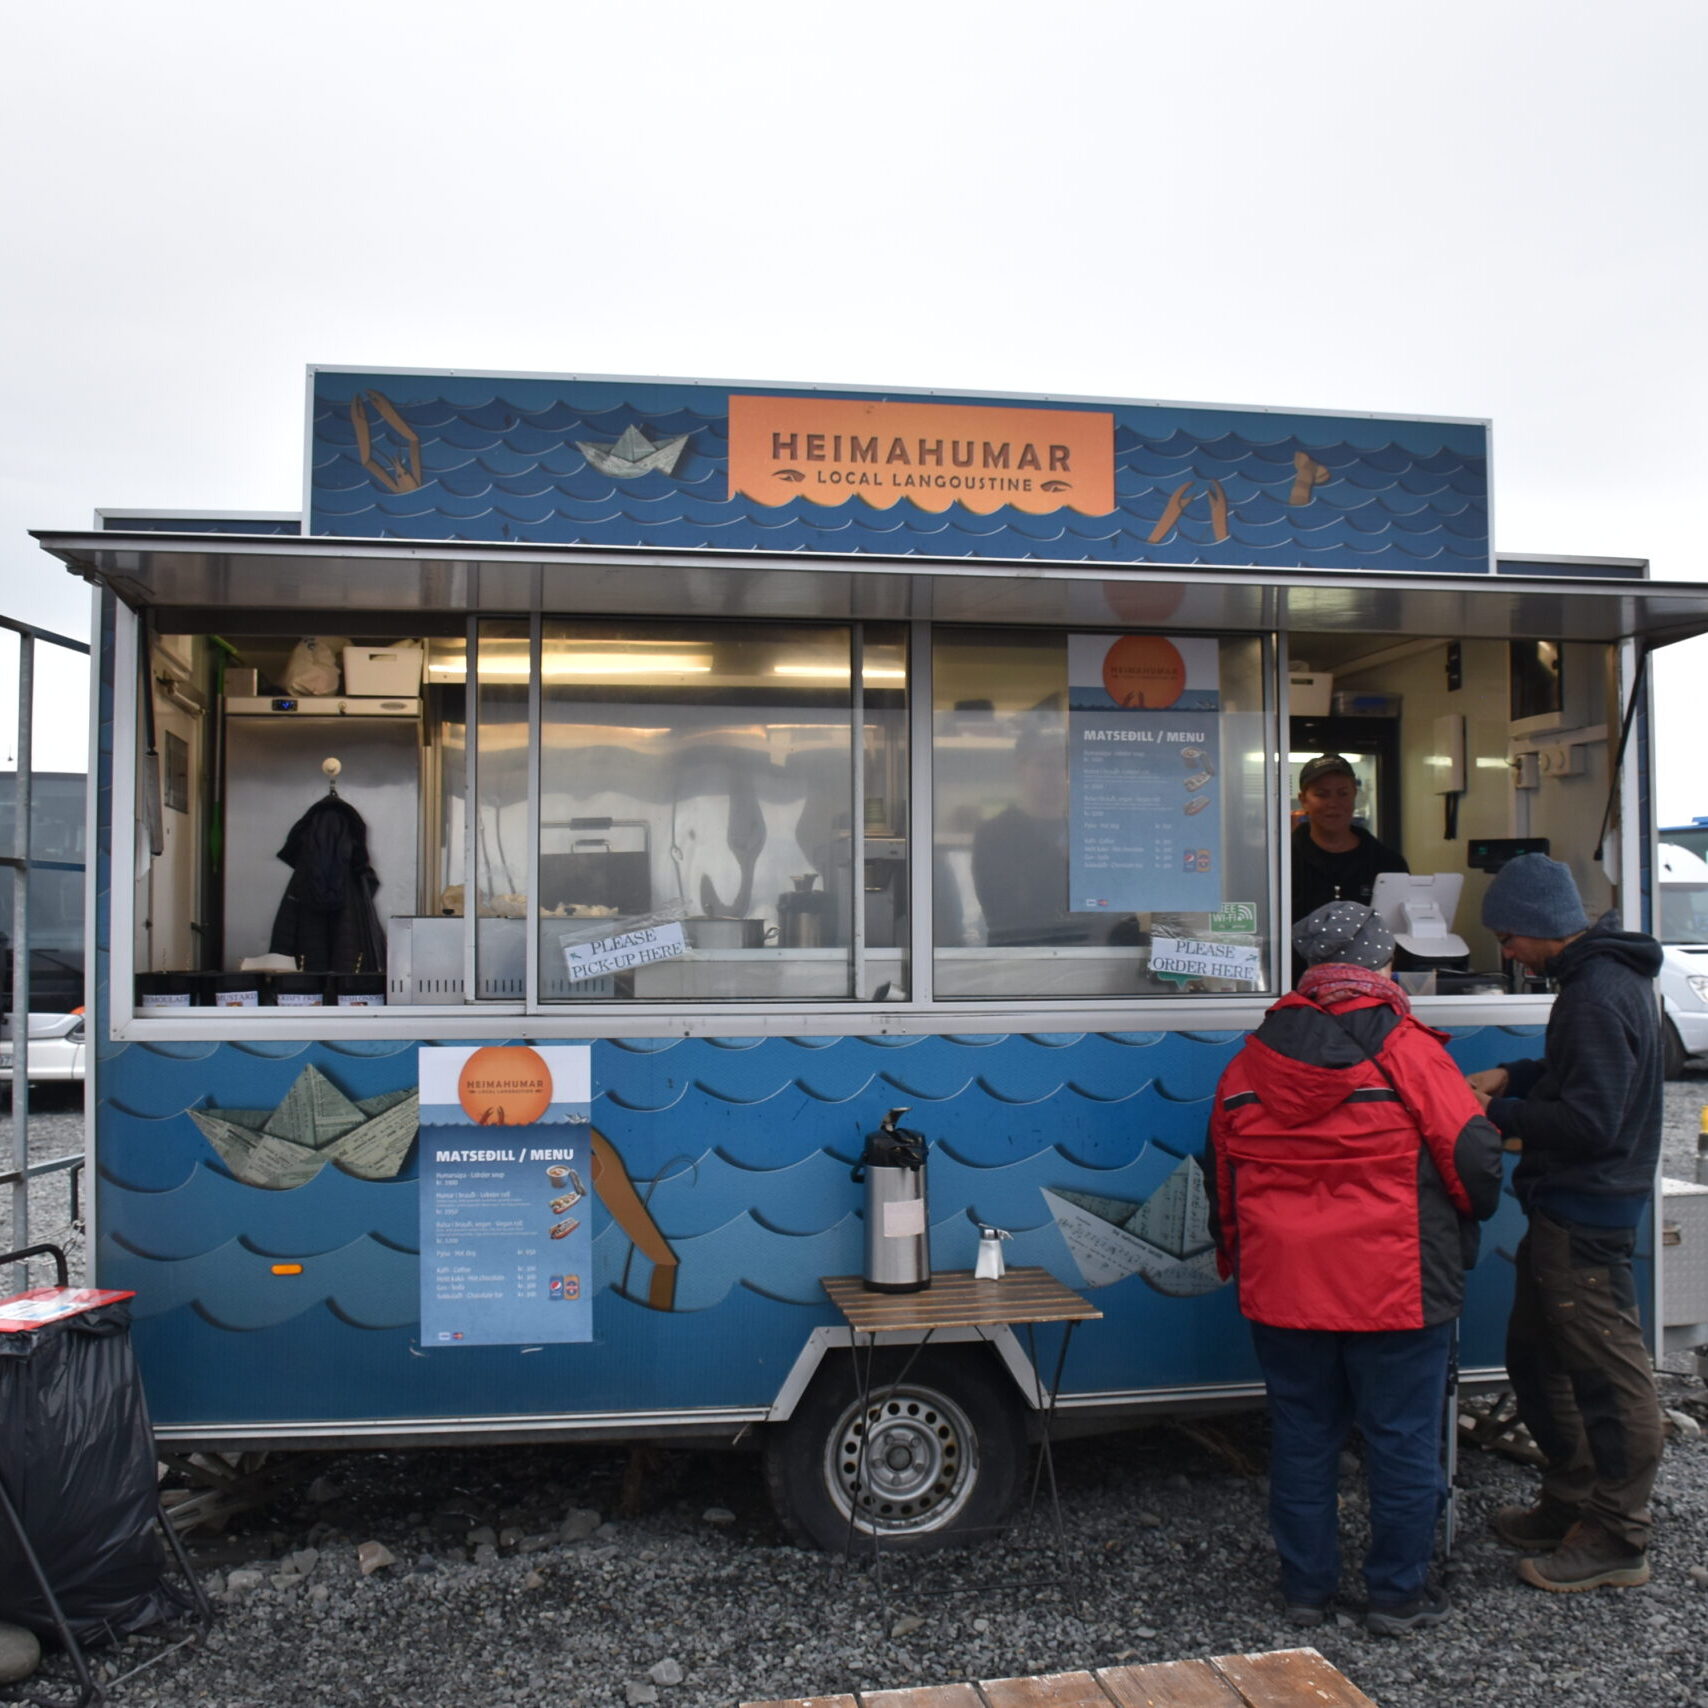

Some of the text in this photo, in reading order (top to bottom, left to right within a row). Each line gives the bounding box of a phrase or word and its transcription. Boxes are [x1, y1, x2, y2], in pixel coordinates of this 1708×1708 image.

[771, 431, 1072, 473] HEIMAHUMAR
[817, 469, 1034, 493] LOCAL LANGOUSTINE
[1166, 732, 1206, 744] MENU
[590, 929, 657, 956] PLEASE
[1175, 939, 1237, 959] PLEASE
[572, 942, 683, 979] PICK-UP HERE
[1152, 957, 1255, 980] ORDER HERE
[466, 1079, 544, 1089] HEIMAHUMAR
[530, 1148, 574, 1161] MENU
